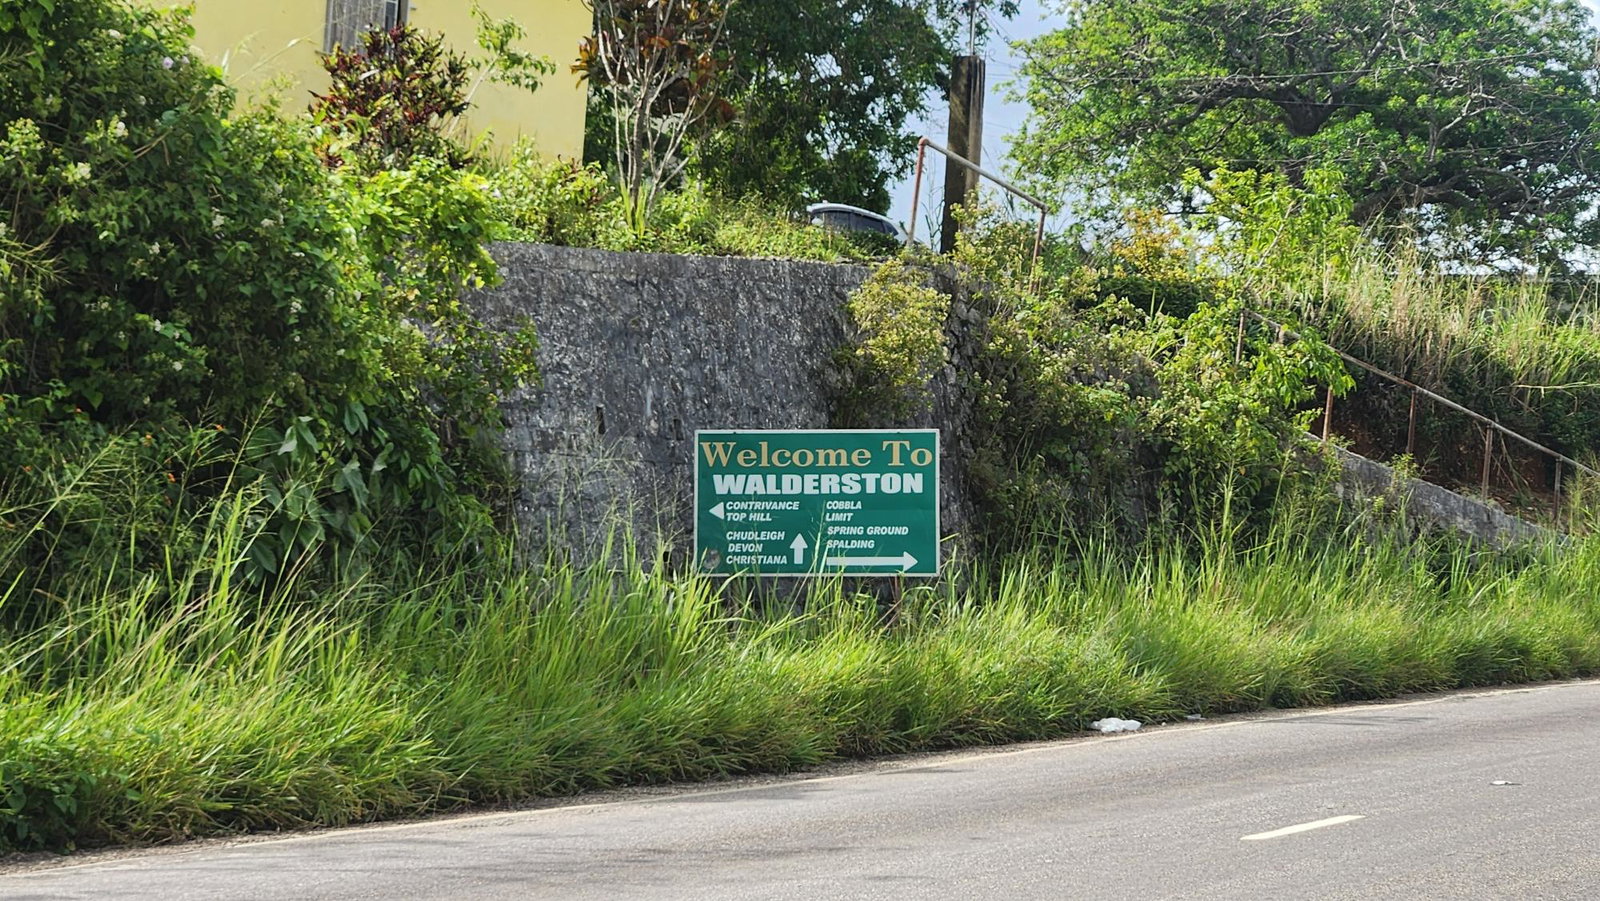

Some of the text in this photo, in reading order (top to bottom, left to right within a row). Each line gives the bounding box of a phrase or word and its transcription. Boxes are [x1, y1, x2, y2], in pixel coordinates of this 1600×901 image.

[700, 440, 933, 468] Welcome To
[712, 473, 924, 495] WALDERSTON
[726, 501, 800, 510] CONTRIVANCE
[826, 500, 862, 510] COBBLA
[726, 512, 772, 522] TOP HILL
[825, 512, 853, 522] LIMIT
[726, 531, 785, 541] CHUDLEIGH
[827, 526, 909, 536] SPRING GROUND
[728, 543, 763, 553] DEVON
[826, 539, 875, 549] SPALDING
[726, 555, 787, 565] CHRISTIANA
